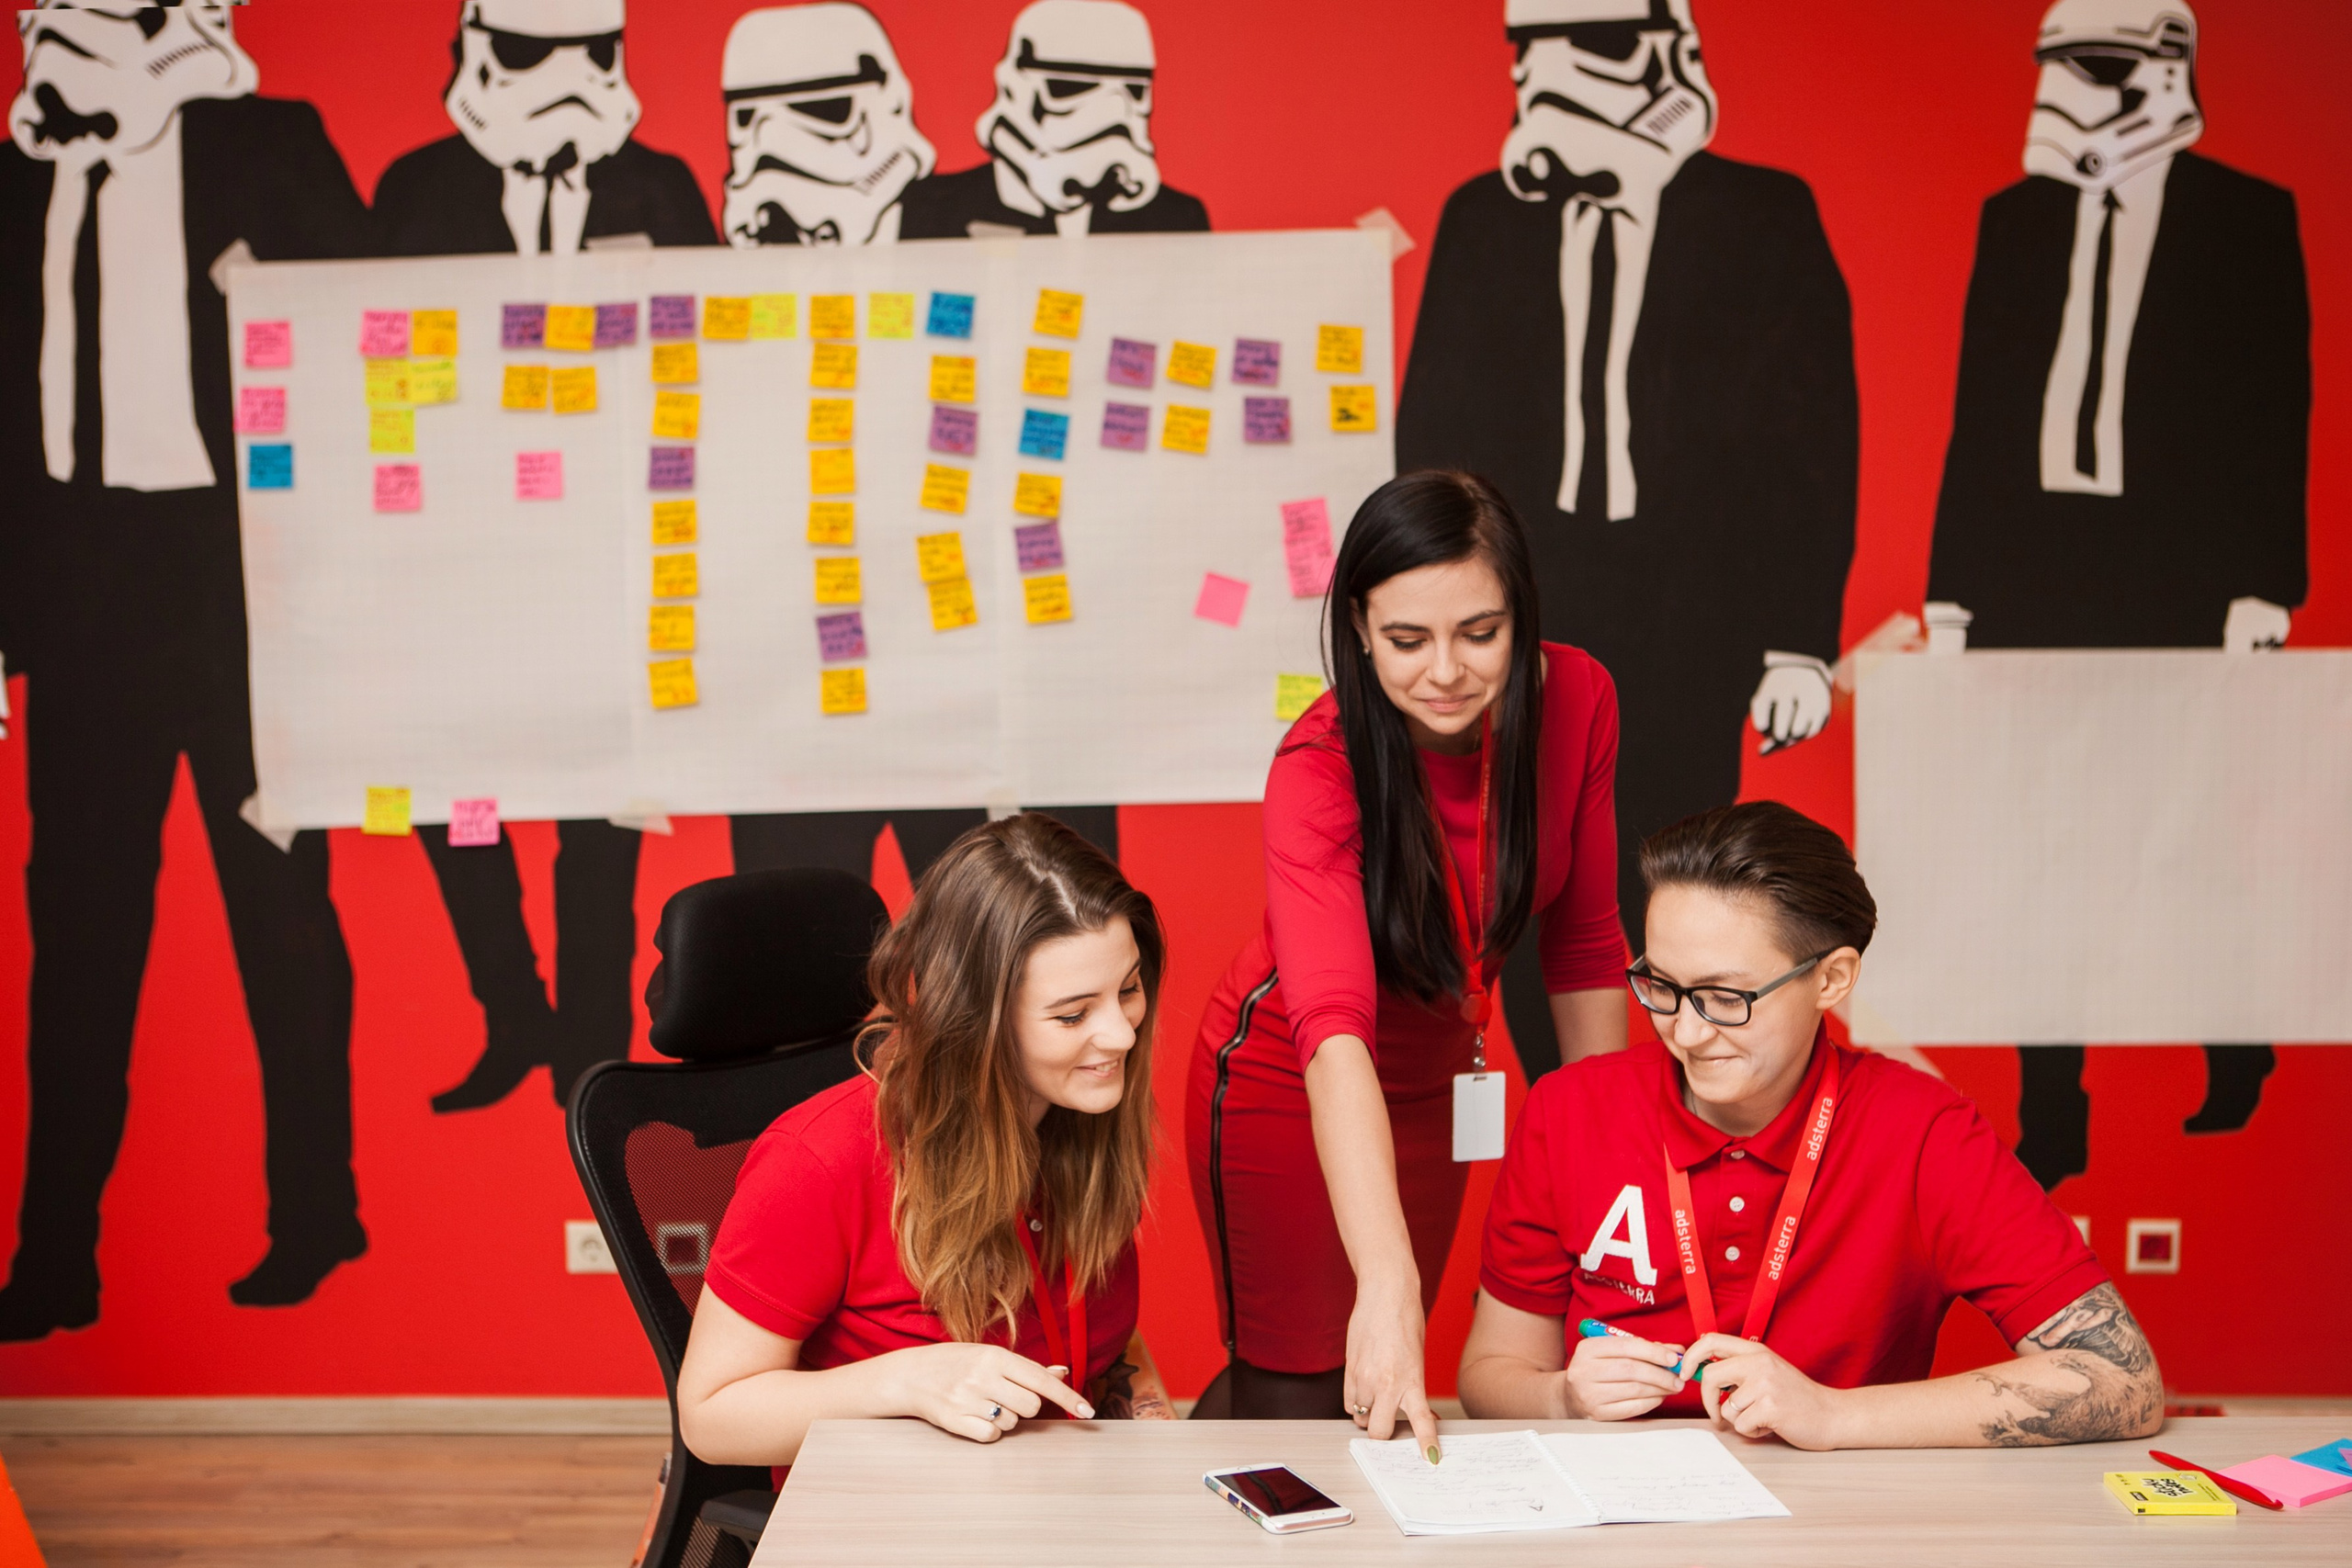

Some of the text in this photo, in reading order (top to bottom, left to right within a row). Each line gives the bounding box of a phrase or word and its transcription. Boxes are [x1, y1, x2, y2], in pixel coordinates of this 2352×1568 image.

[1806, 1097, 1833, 1161] adsterra
[1580, 1184, 1657, 1286] A
[1674, 1209, 1696, 1275] adsterra
[1768, 1215, 1796, 1280] adsterra
